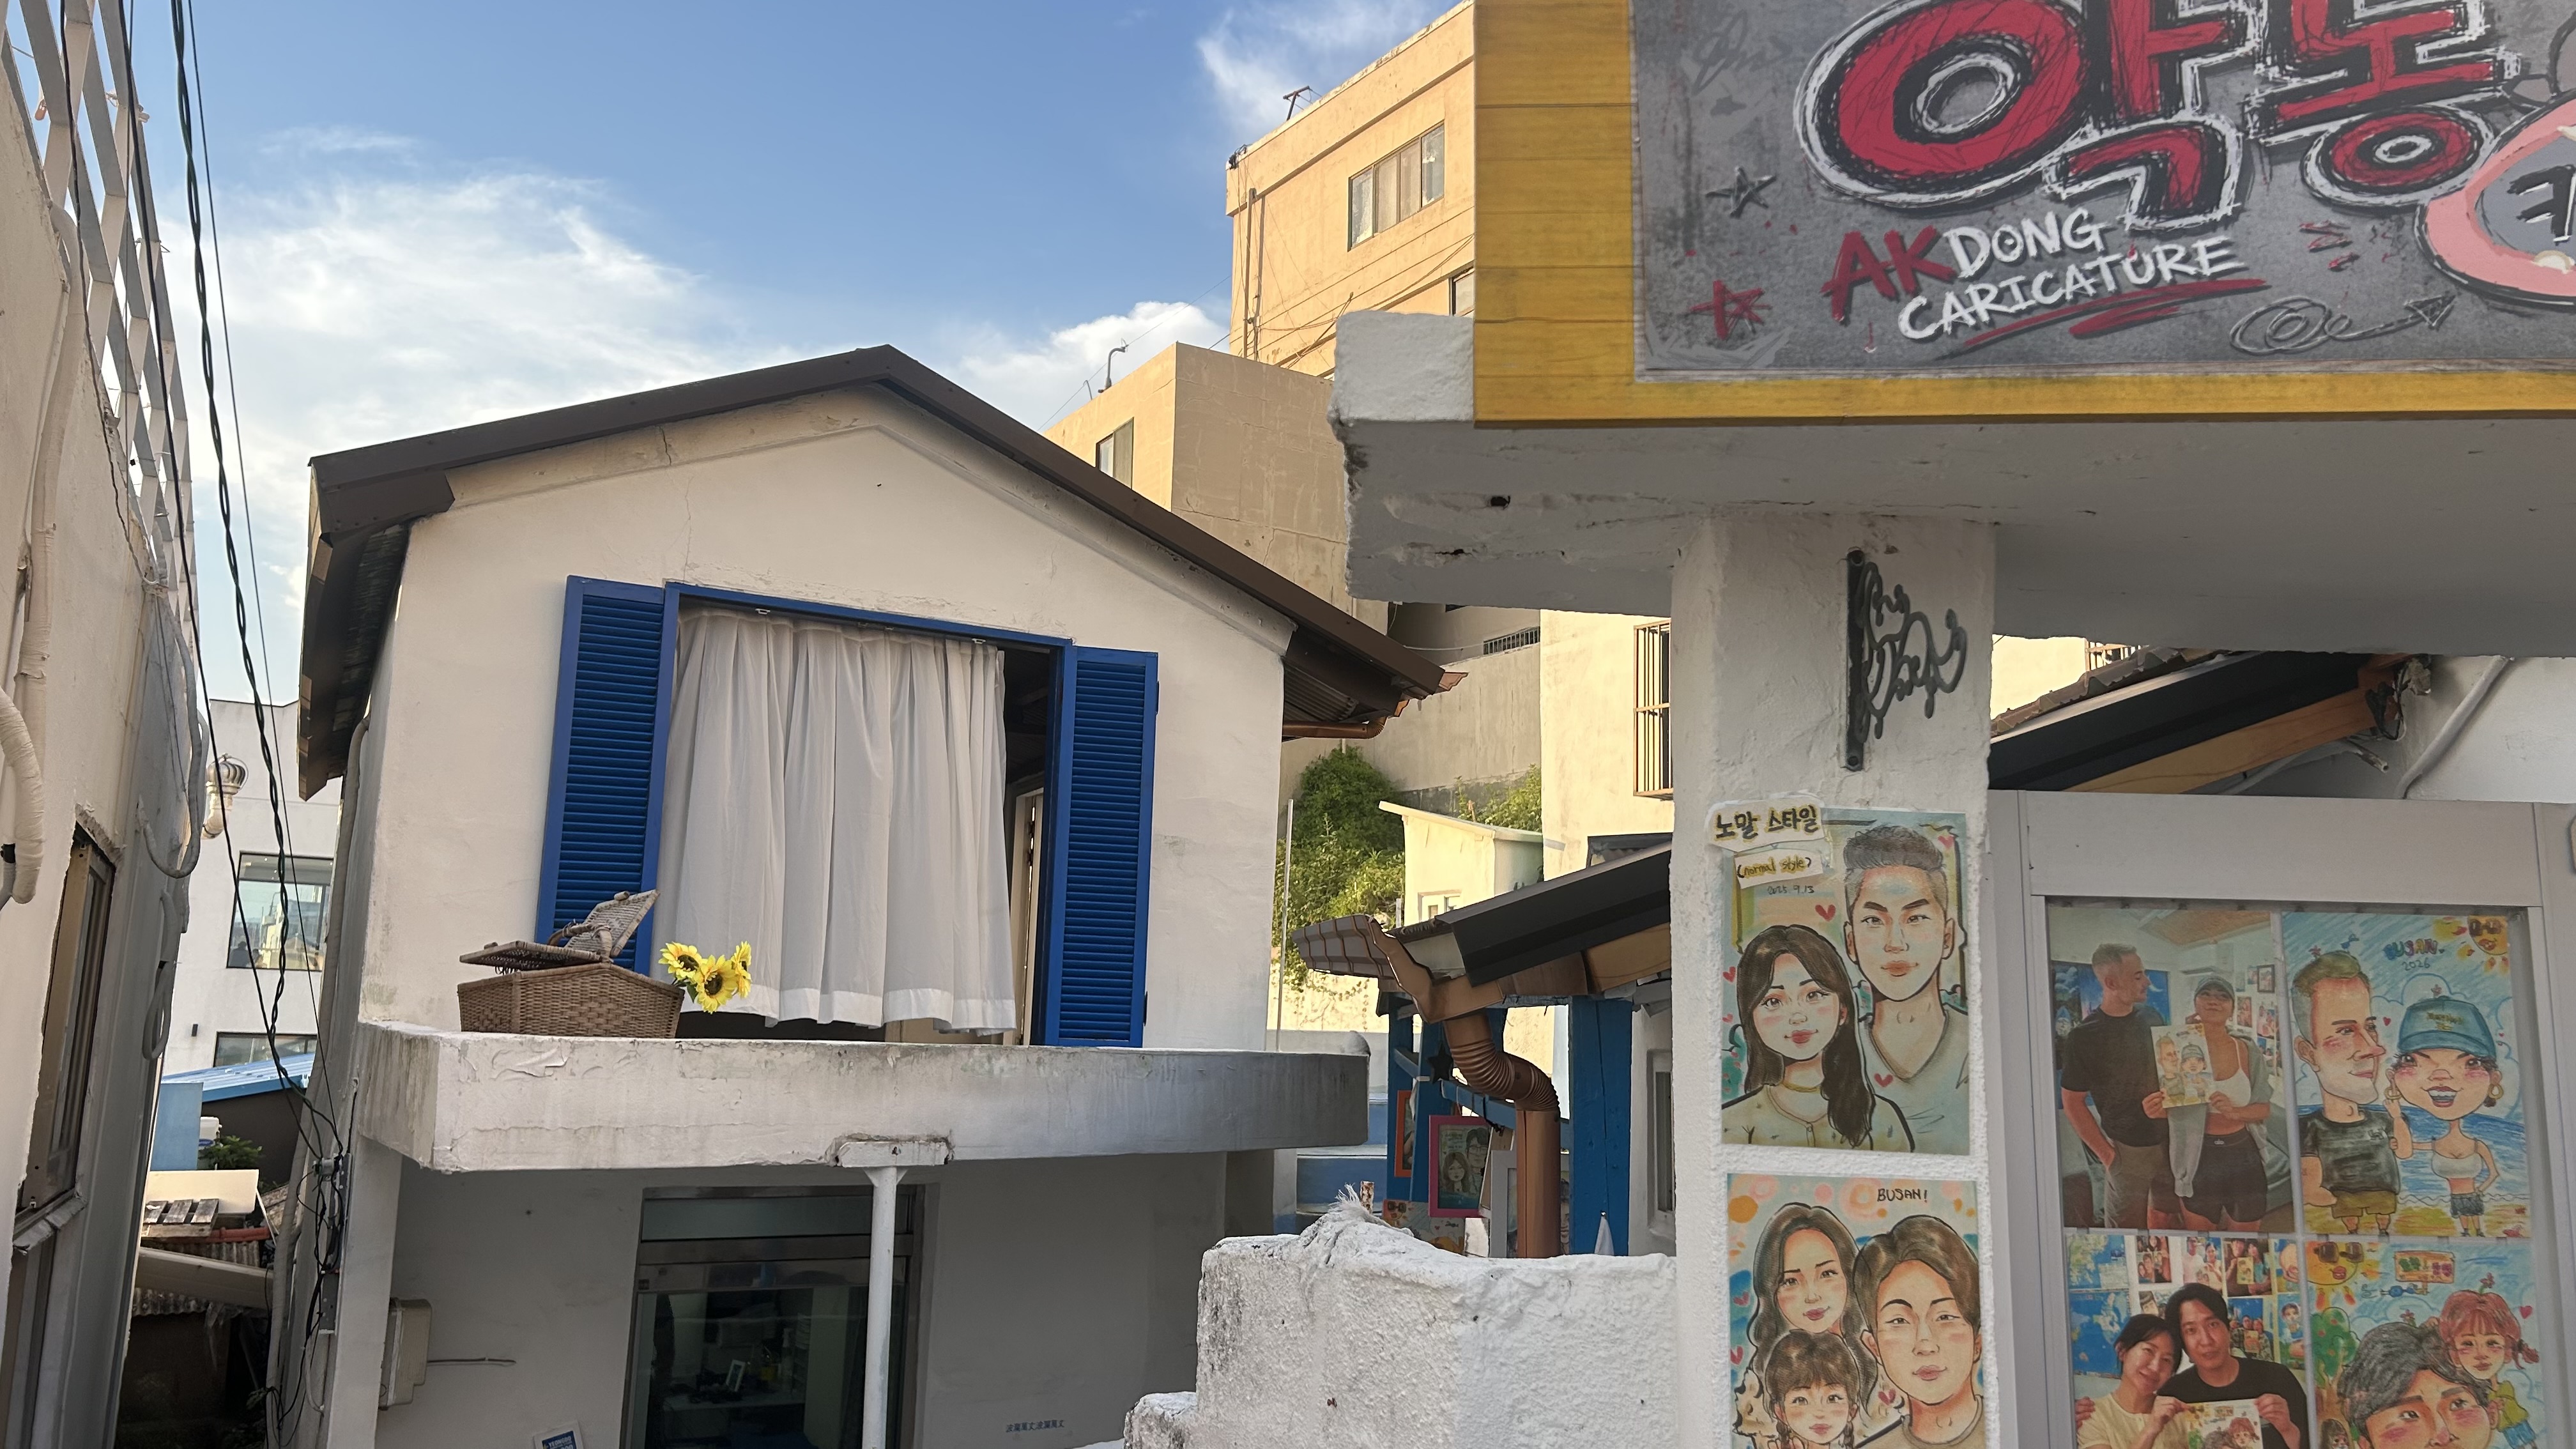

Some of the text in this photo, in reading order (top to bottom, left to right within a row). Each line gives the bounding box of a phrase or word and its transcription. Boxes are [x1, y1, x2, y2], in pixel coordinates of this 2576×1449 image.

[1821, 208, 2112, 321] AKDONG
[1897, 235, 2244, 341] CARICATURE
[1715, 804, 1820, 839] 노말 스타일
[1736, 857, 1813, 878] (normal style)
[2402, 958, 2431, 971] 2026
[1876, 1188, 1928, 1204] BUSAN!
